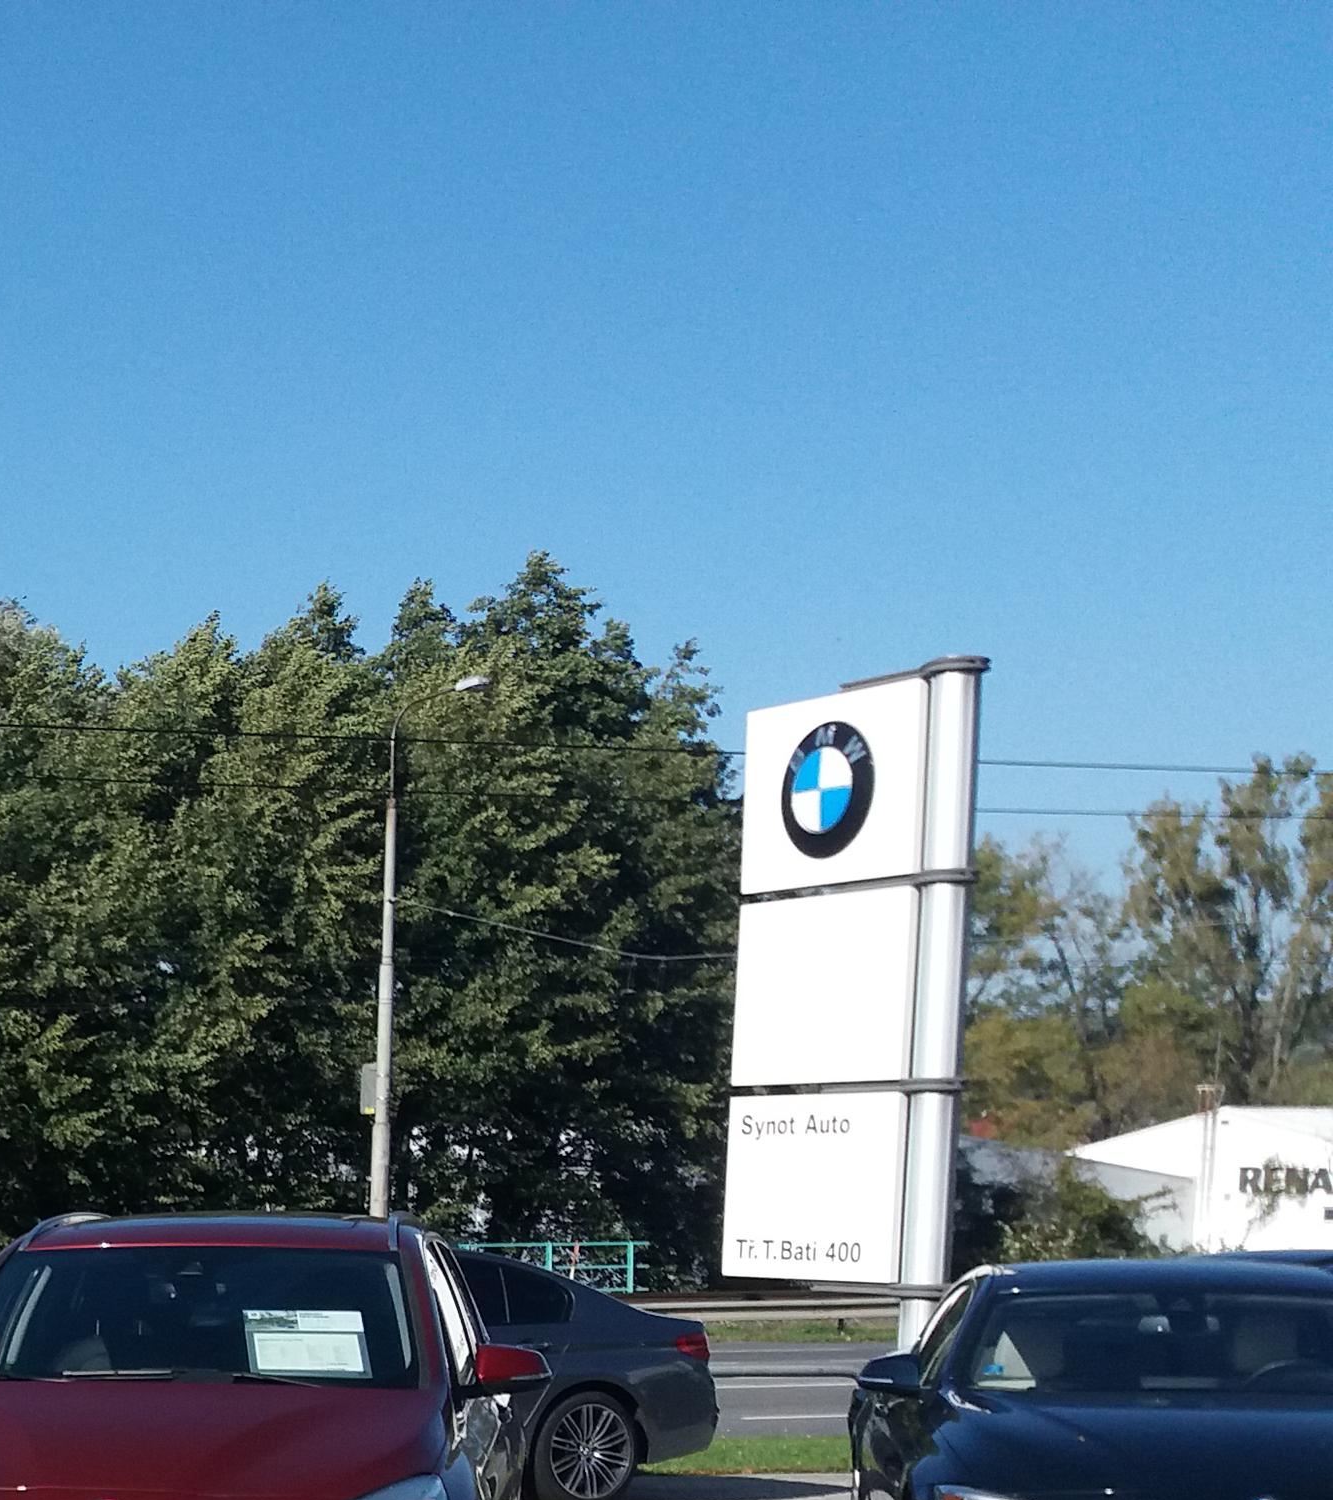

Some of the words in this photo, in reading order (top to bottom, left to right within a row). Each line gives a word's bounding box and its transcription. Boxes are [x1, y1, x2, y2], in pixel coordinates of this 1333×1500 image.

[741, 1114, 795, 1141] Synot
[805, 1114, 851, 1135] Auto
[825, 1241, 862, 1263] 400
